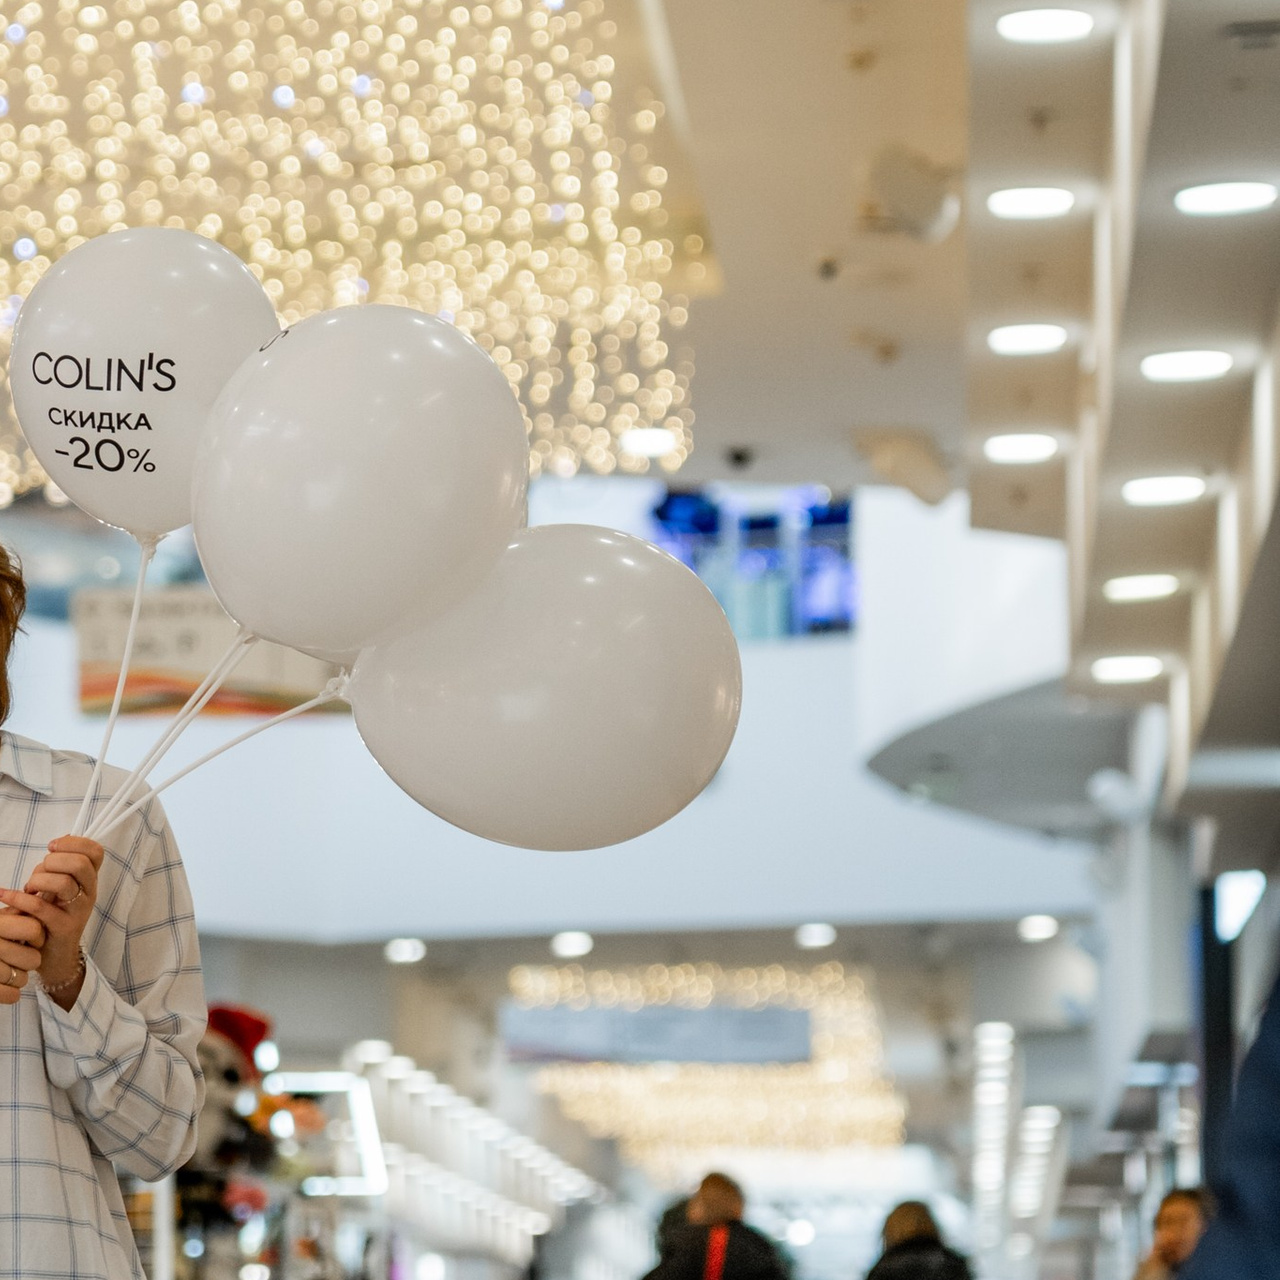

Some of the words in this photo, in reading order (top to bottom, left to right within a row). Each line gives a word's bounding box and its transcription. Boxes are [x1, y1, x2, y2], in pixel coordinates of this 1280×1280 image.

[32, 351, 177, 392] COLIN'S
[48, 407, 153, 433] СКИДКА
[54, 436, 156, 473] -20%
